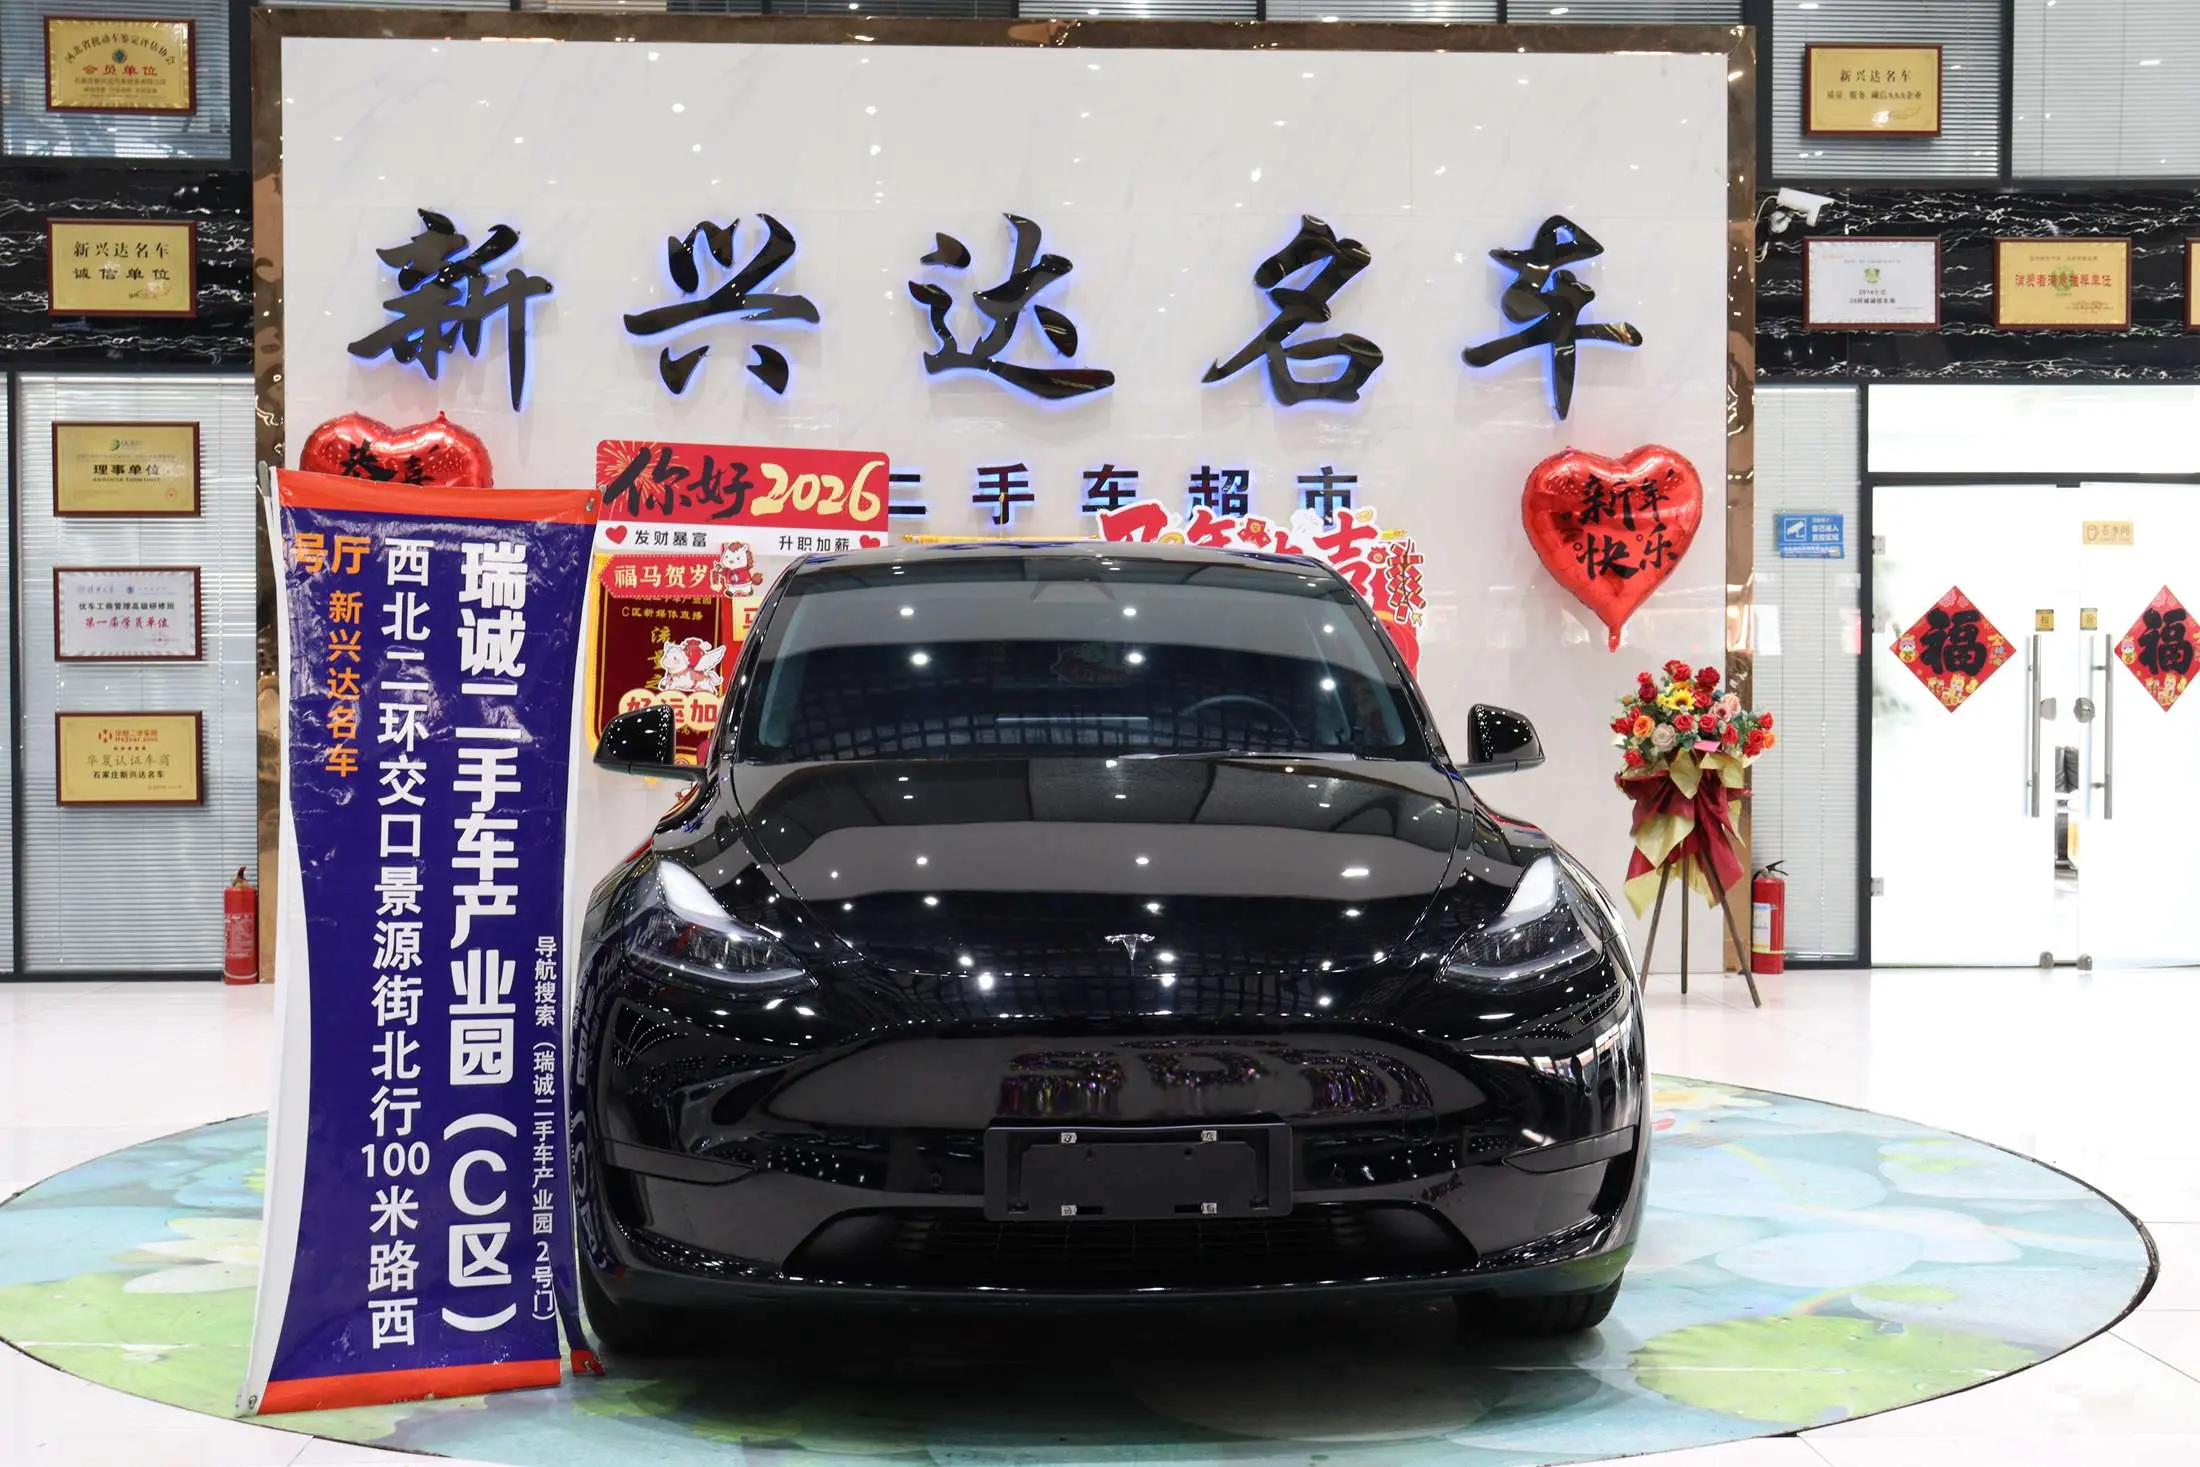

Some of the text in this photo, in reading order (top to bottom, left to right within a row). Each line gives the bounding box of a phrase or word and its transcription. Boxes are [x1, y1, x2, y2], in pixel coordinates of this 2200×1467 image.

[82, 64, 158, 77] 会员单位
[1840, 68, 1912, 83] 新兴达名车
[73, 240, 169, 259] 新兴达名车
[72, 267, 171, 281] 诚信单位
[347, 207, 1644, 420] 新兴达名车
[93, 463, 161, 476] 理事单位
[603, 447, 886, 522] 你好2026
[889, 463, 1358, 526] 二手车超市
[1578, 473, 1670, 531] 新年
[635, 530, 708, 548] 发财暴富
[778, 535, 850, 552] 升职加薪
[1575, 524, 1678, 580] 快乐
[614, 564, 708, 588] 福马贺岁
[621, 606, 704, 621] C区新媒体直播
[1919, 607, 1988, 677] 福
[2138, 607, 2194, 675] 福
[325, 590, 364, 778] 新兴达名车
[361, 537, 434, 1349] 西北二环交口景源街北行100米路西
